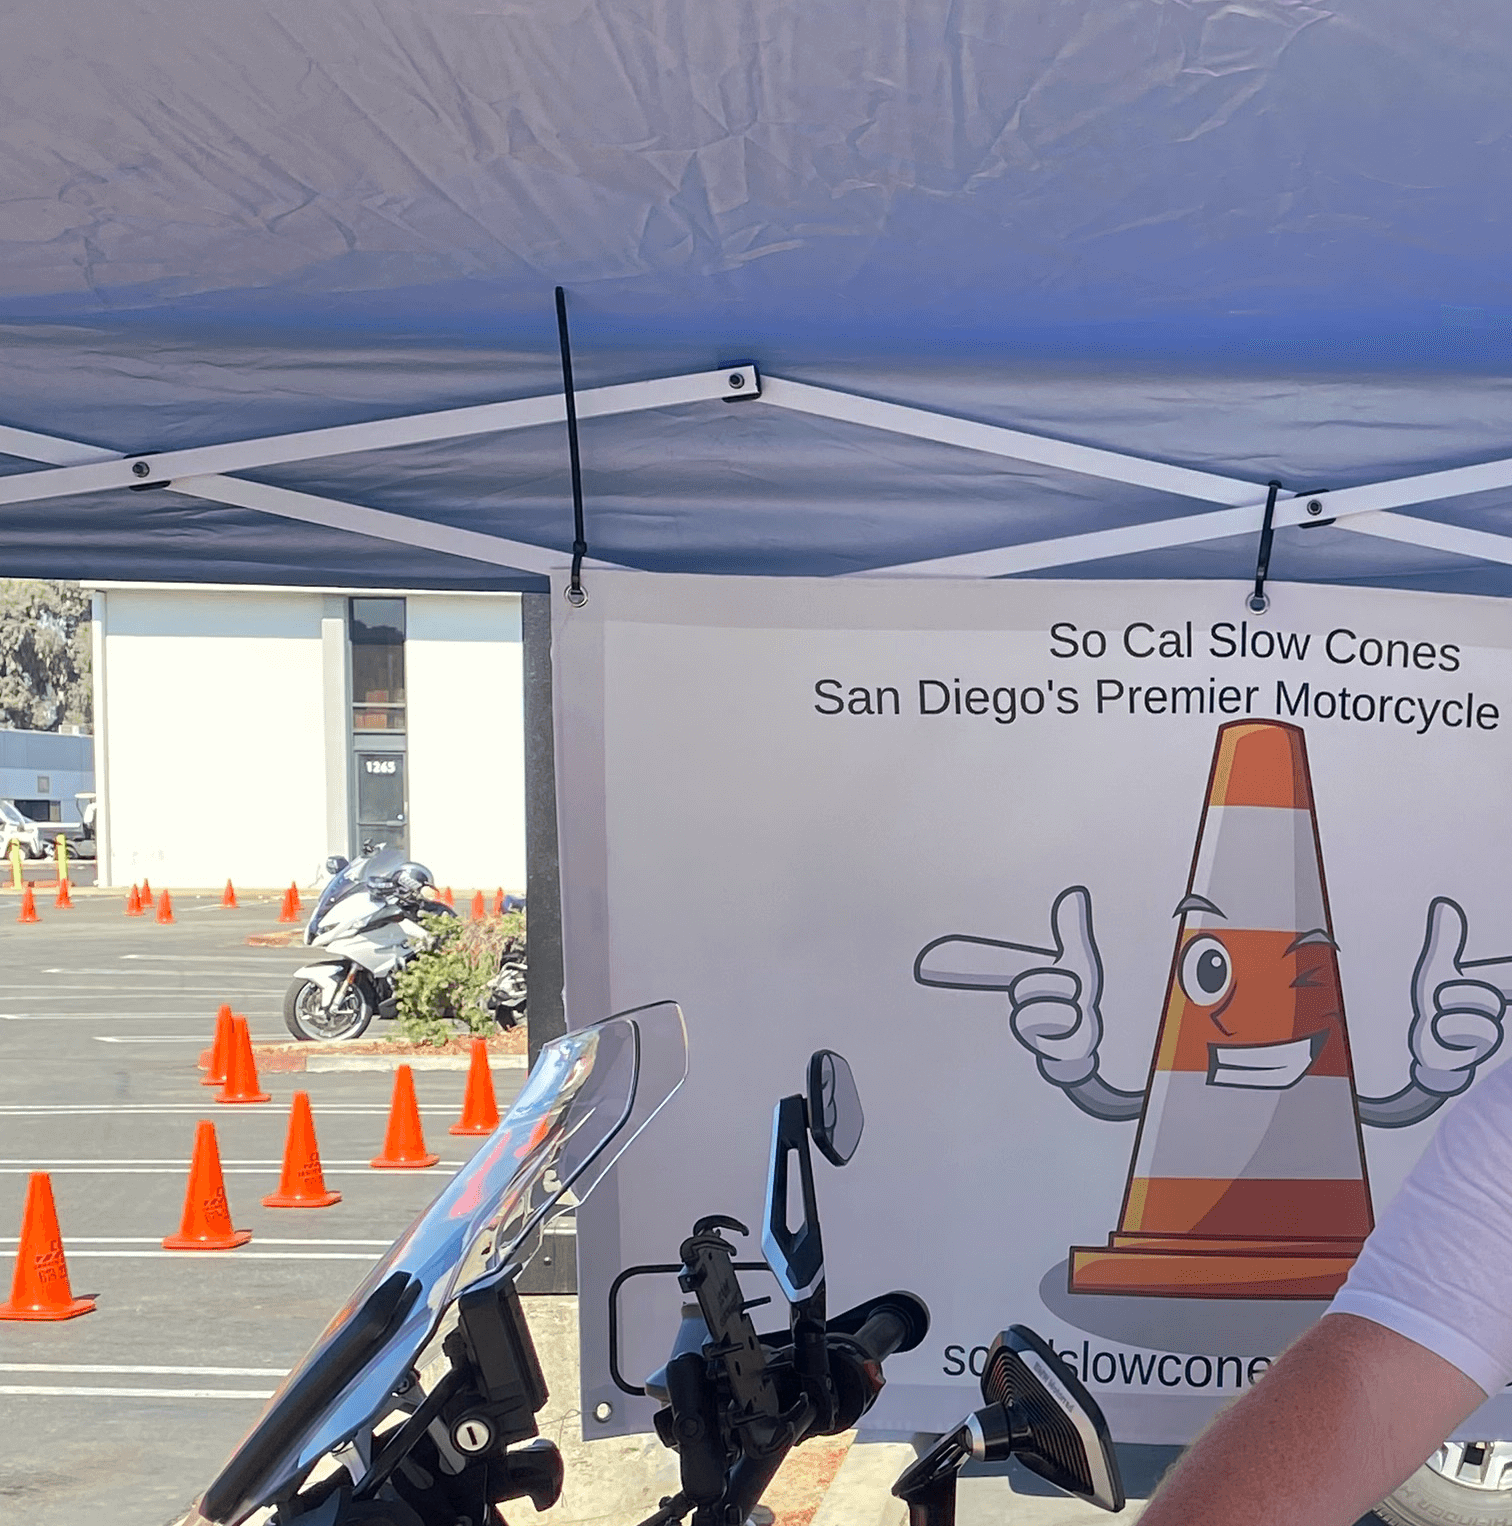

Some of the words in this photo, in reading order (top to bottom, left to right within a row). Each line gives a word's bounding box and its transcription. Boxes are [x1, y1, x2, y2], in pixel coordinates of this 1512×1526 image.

[1049, 622, 1107, 659] So
[1122, 621, 1193, 659] Cal
[1208, 621, 1311, 661] Slow
[1325, 628, 1461, 672] Cones
[813, 678, 900, 715] San
[918, 678, 1080, 725] Diego's
[1097, 677, 1259, 715] Premier
[1276, 680, 1500, 735] Motorcycle
[366, 760, 396, 774] 1265
